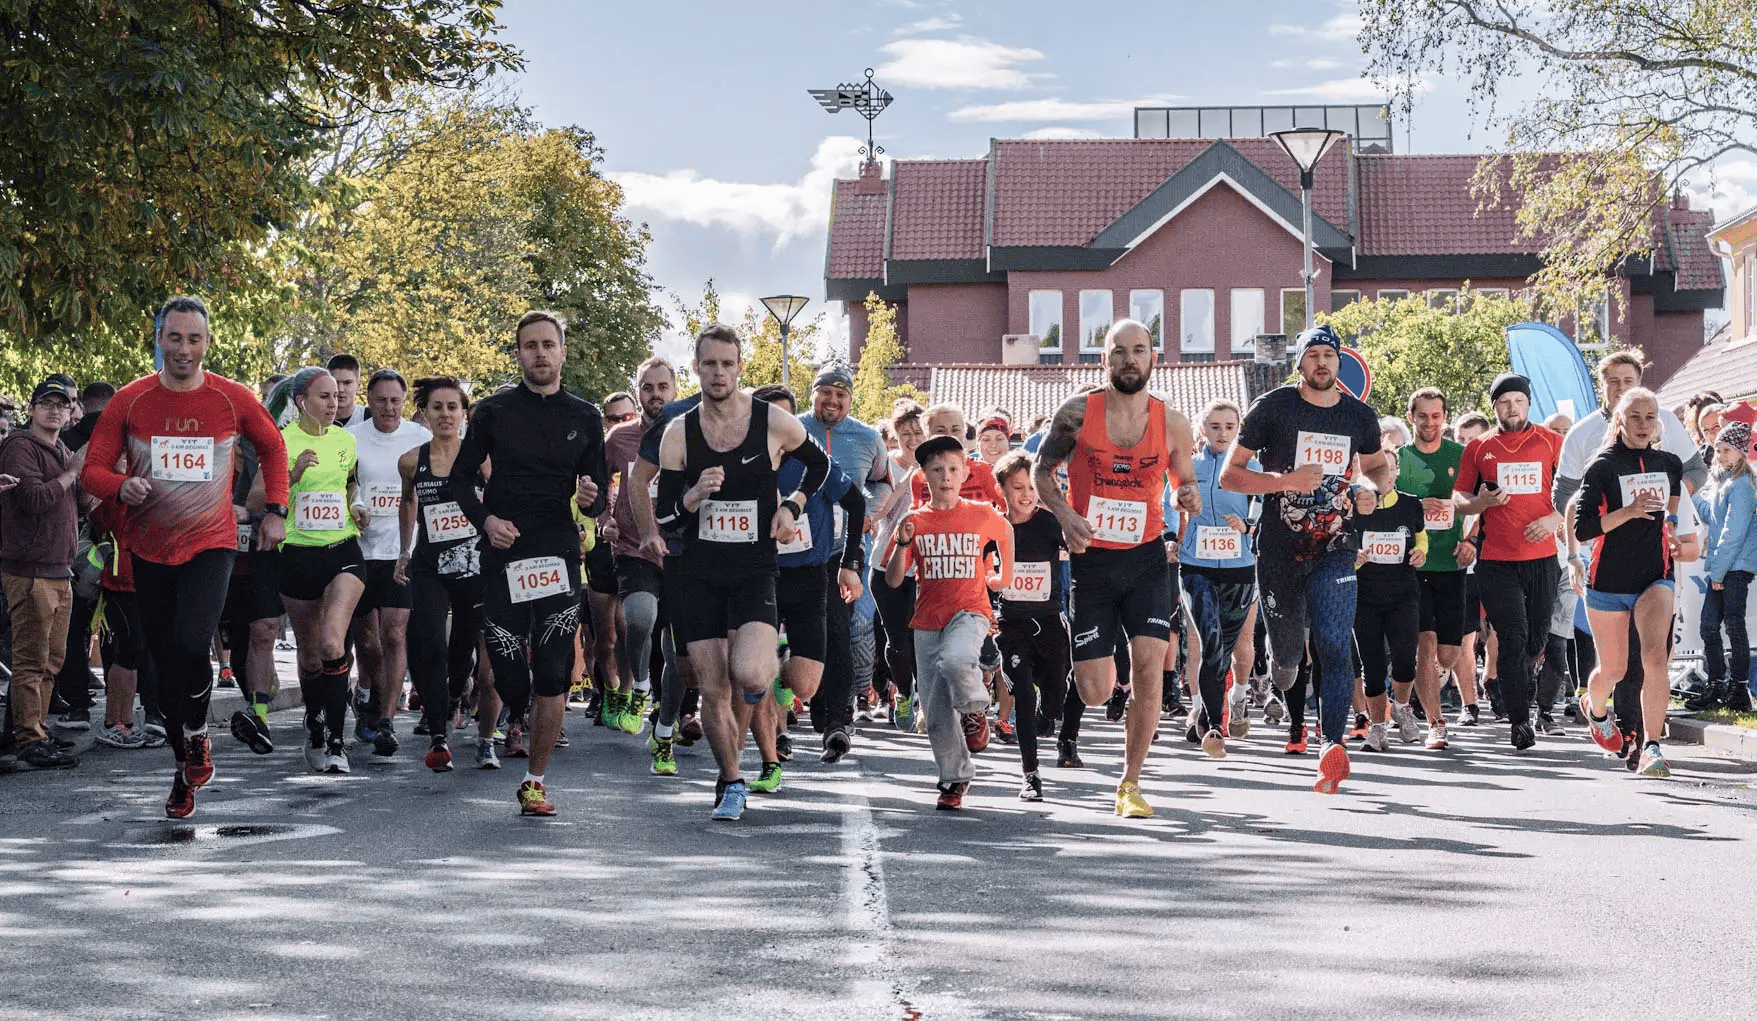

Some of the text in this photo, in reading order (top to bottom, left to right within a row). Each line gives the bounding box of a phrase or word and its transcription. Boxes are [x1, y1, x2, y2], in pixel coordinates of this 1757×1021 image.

[165, 417, 199, 432] run
[161, 452, 206, 470] 1164
[1304, 447, 1344, 465] 1198
[1503, 473, 1537, 486] 1115
[303, 505, 340, 520] 1023
[1425, 510, 1449, 521] 025
[432, 514, 470, 531] 1259
[706, 515, 750, 531] 1118
[1095, 514, 1138, 533] 1113
[915, 533, 981, 557] ORANGE
[1201, 538, 1236, 551] 1136
[1368, 543, 1400, 555] 1029
[923, 556, 976, 579] CRUSH
[517, 569, 561, 591] 1054
[1008, 576, 1044, 591] 087
[1074, 625, 1100, 648] Spirit
